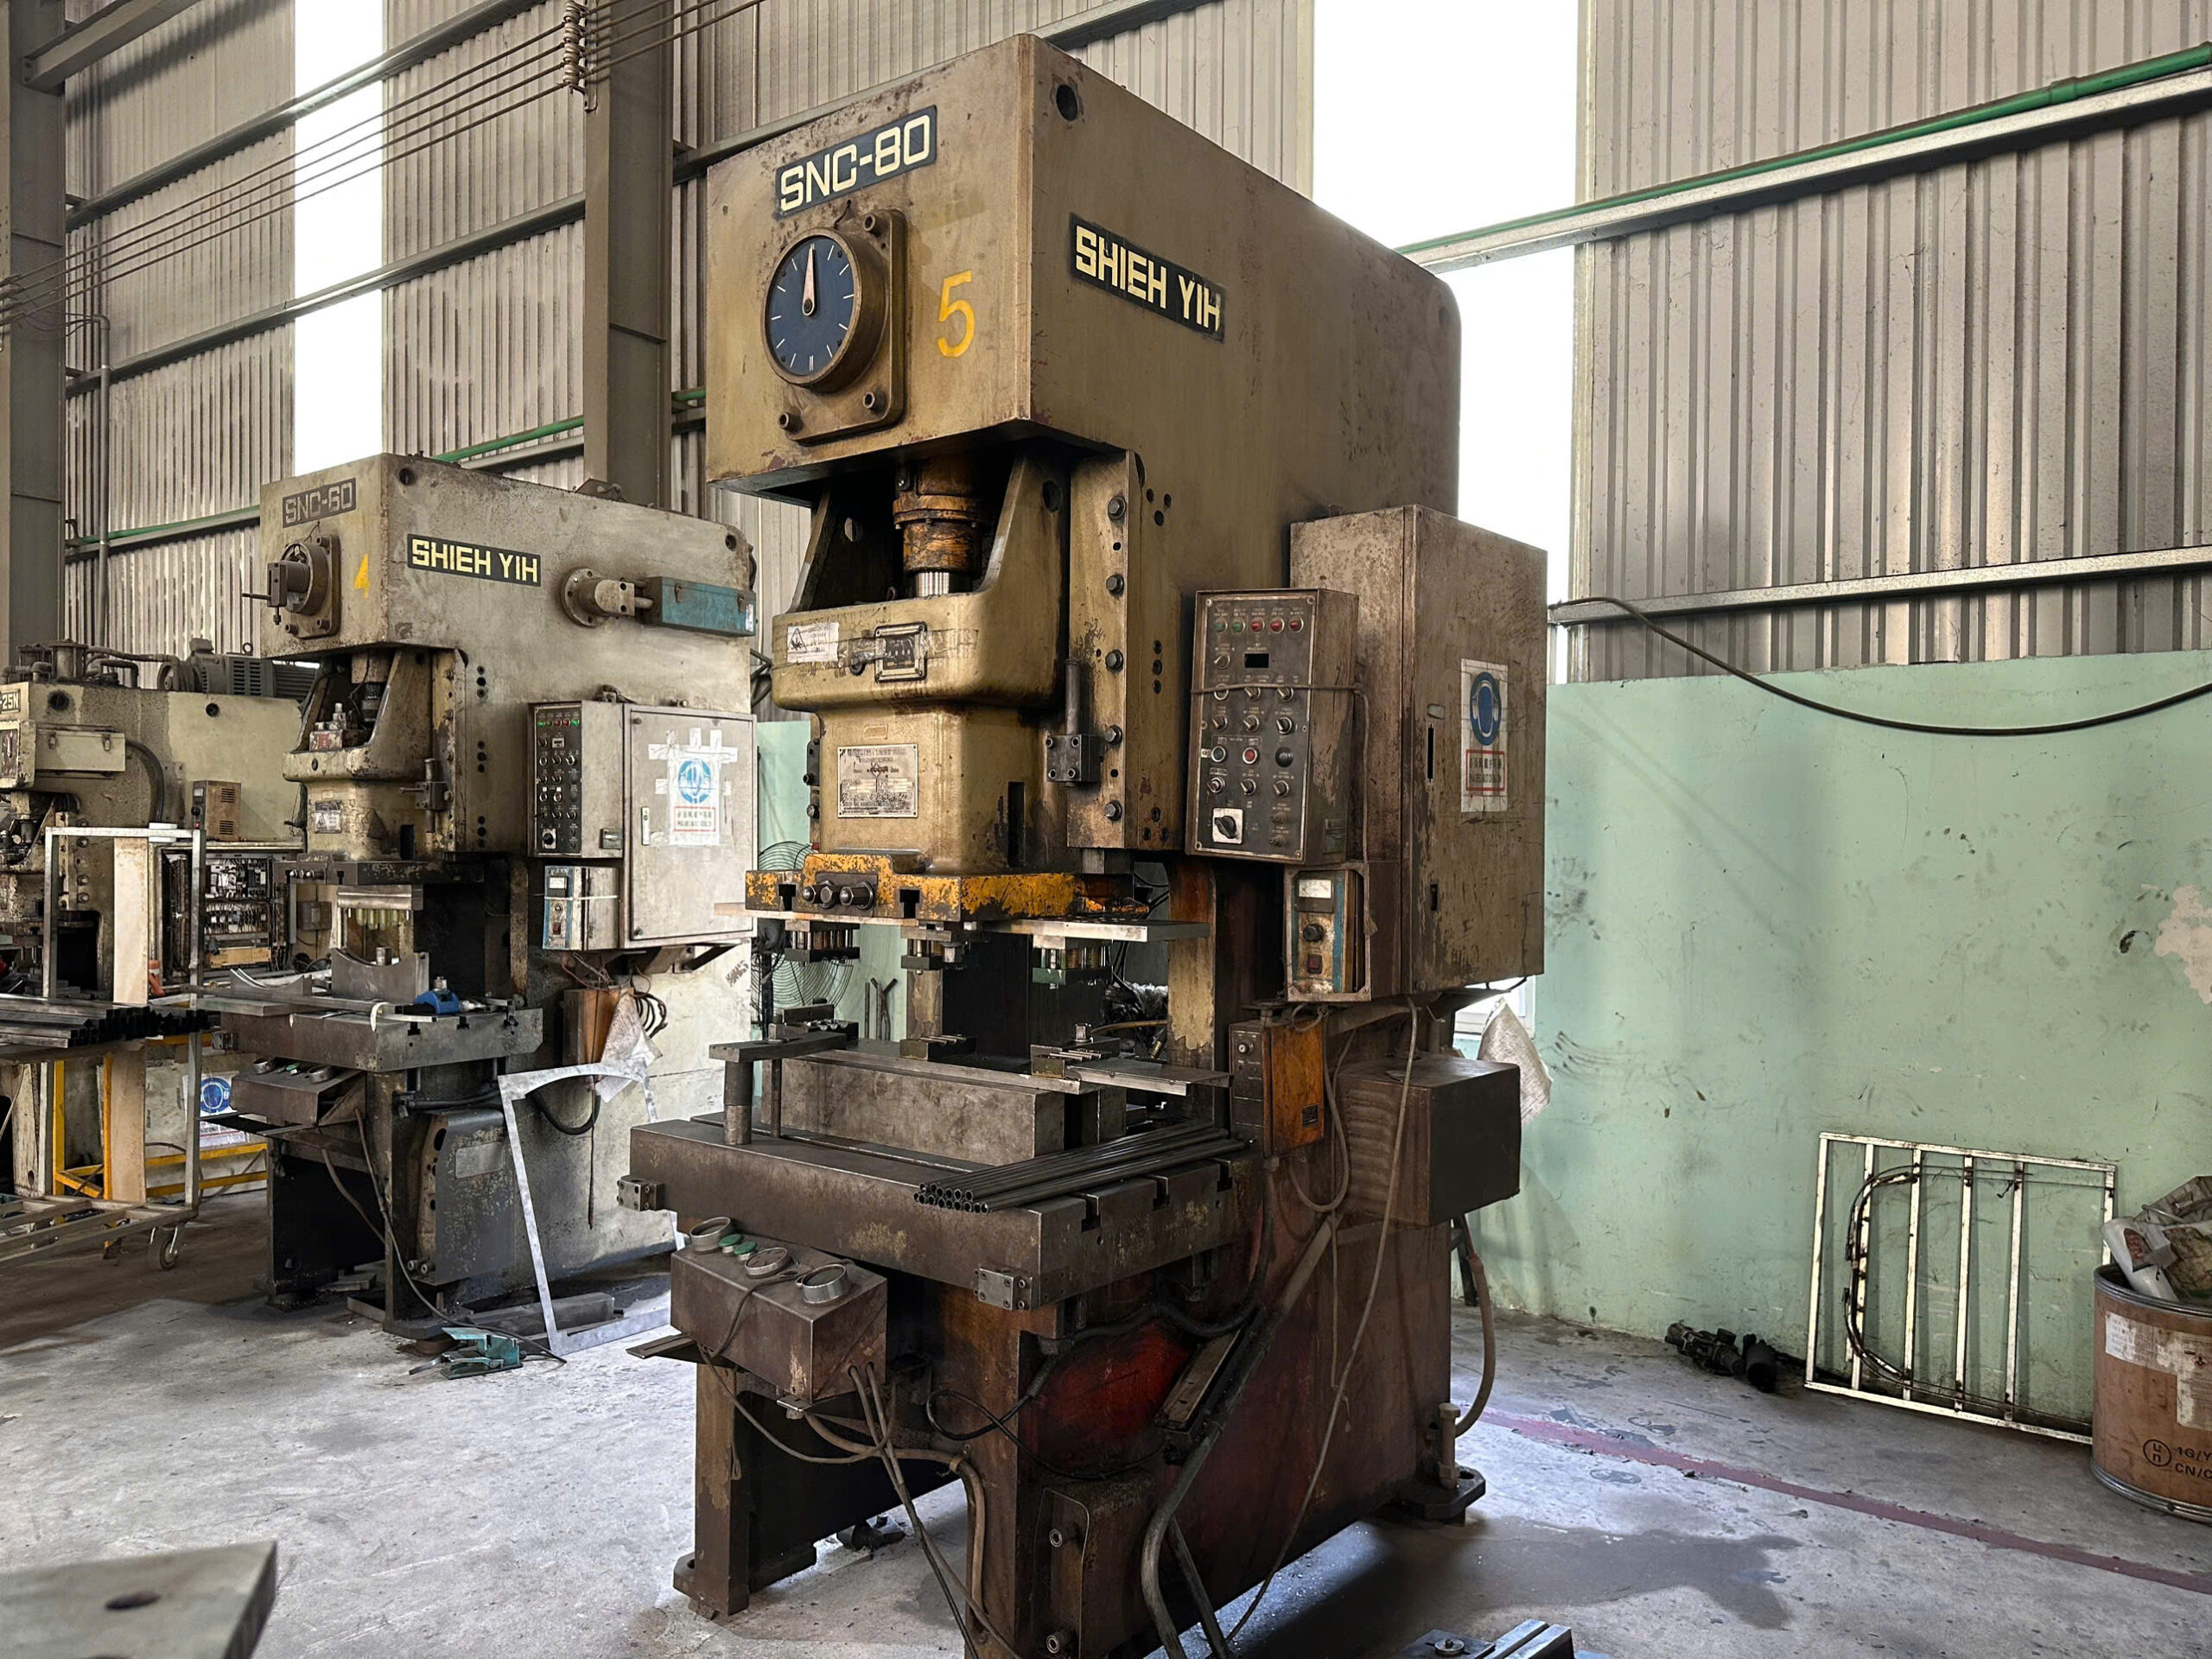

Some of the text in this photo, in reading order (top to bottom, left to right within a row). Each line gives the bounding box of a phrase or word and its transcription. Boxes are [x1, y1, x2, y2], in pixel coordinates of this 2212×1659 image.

[780, 114, 931, 212] SNC-80
[1076, 225, 1221, 332] SHIEH YIH
[937, 270, 976, 358] 5
[285, 481, 353, 524] SNC-60
[354, 553, 369, 599] 4
[412, 538, 537, 583] SHIEH YIH
